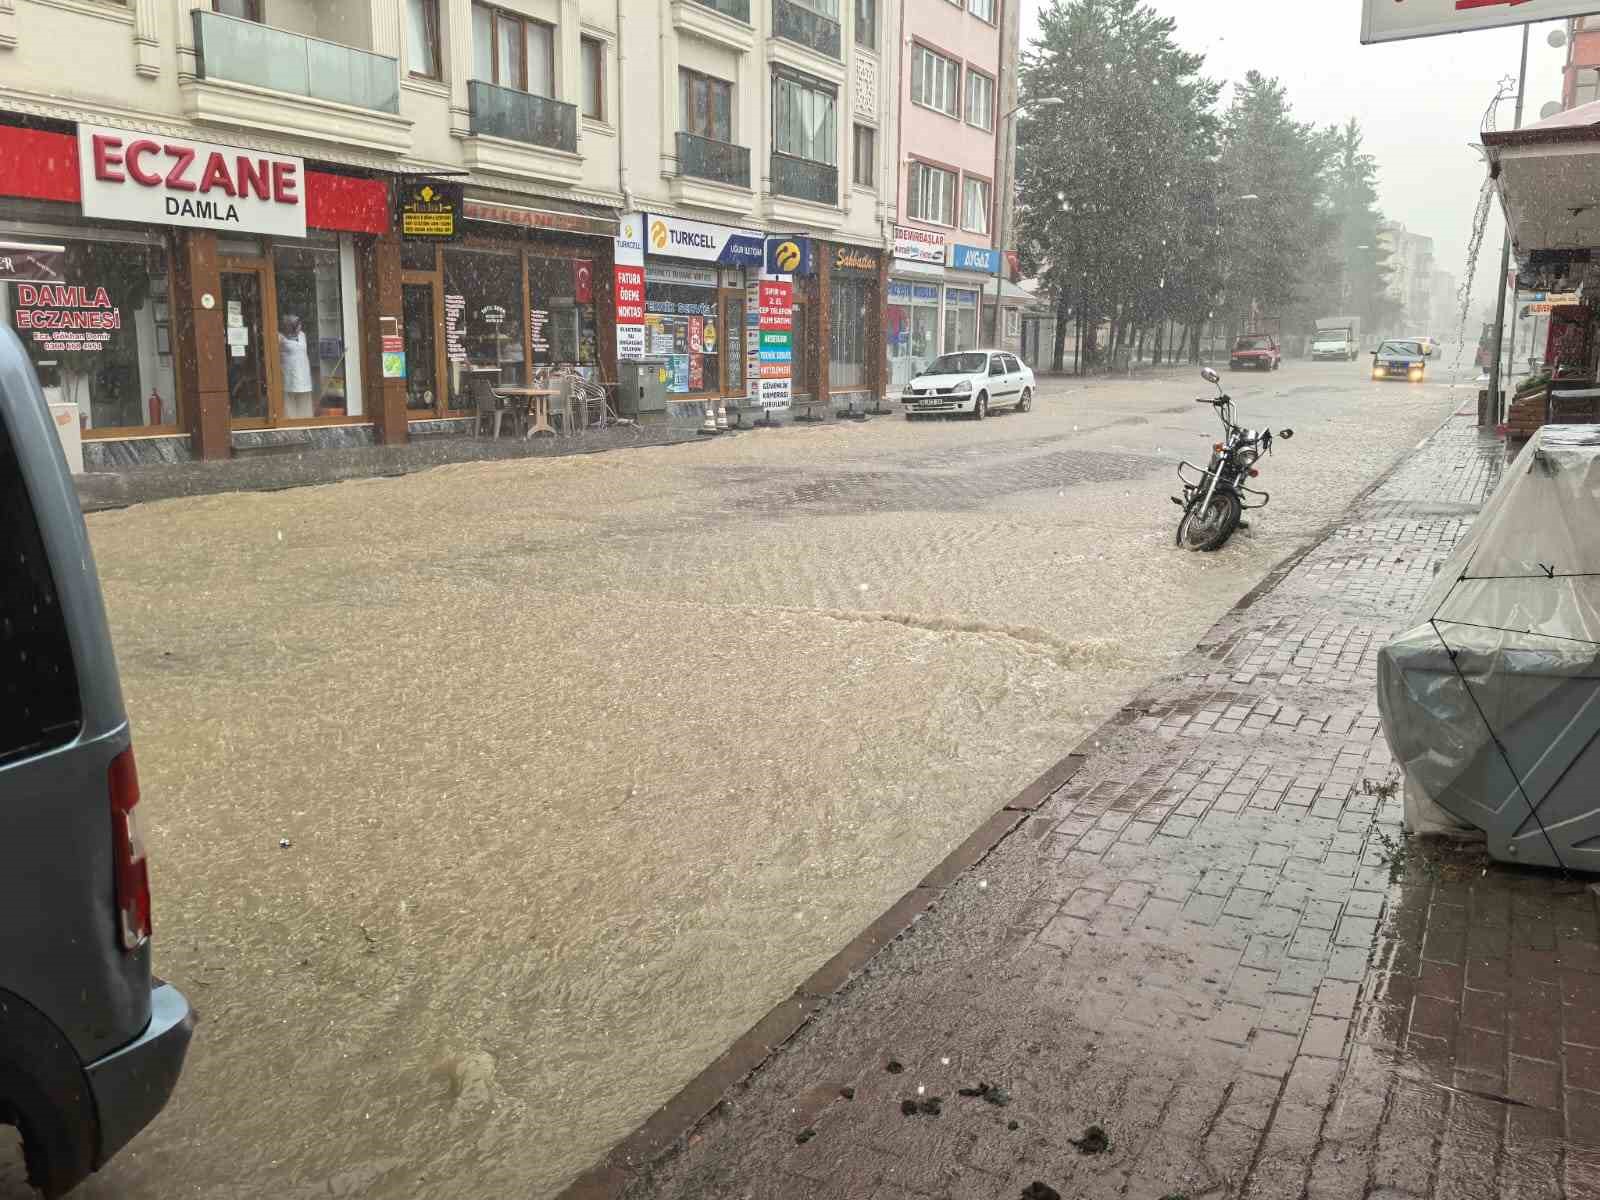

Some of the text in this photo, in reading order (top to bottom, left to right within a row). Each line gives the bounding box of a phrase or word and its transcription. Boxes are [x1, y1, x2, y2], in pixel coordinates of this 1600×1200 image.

[92, 134, 299, 204] ECZANE
[165, 197, 240, 222] DAMLA
[670, 229, 717, 249] TURKCELL
[964, 249, 990, 268] AYGAZ
[618, 272, 641, 285] FATURA
[17, 284, 112, 308] DAMLA
[620, 289, 640, 301] ÖDEME
[16, 306, 120, 329] ECZANESİ
